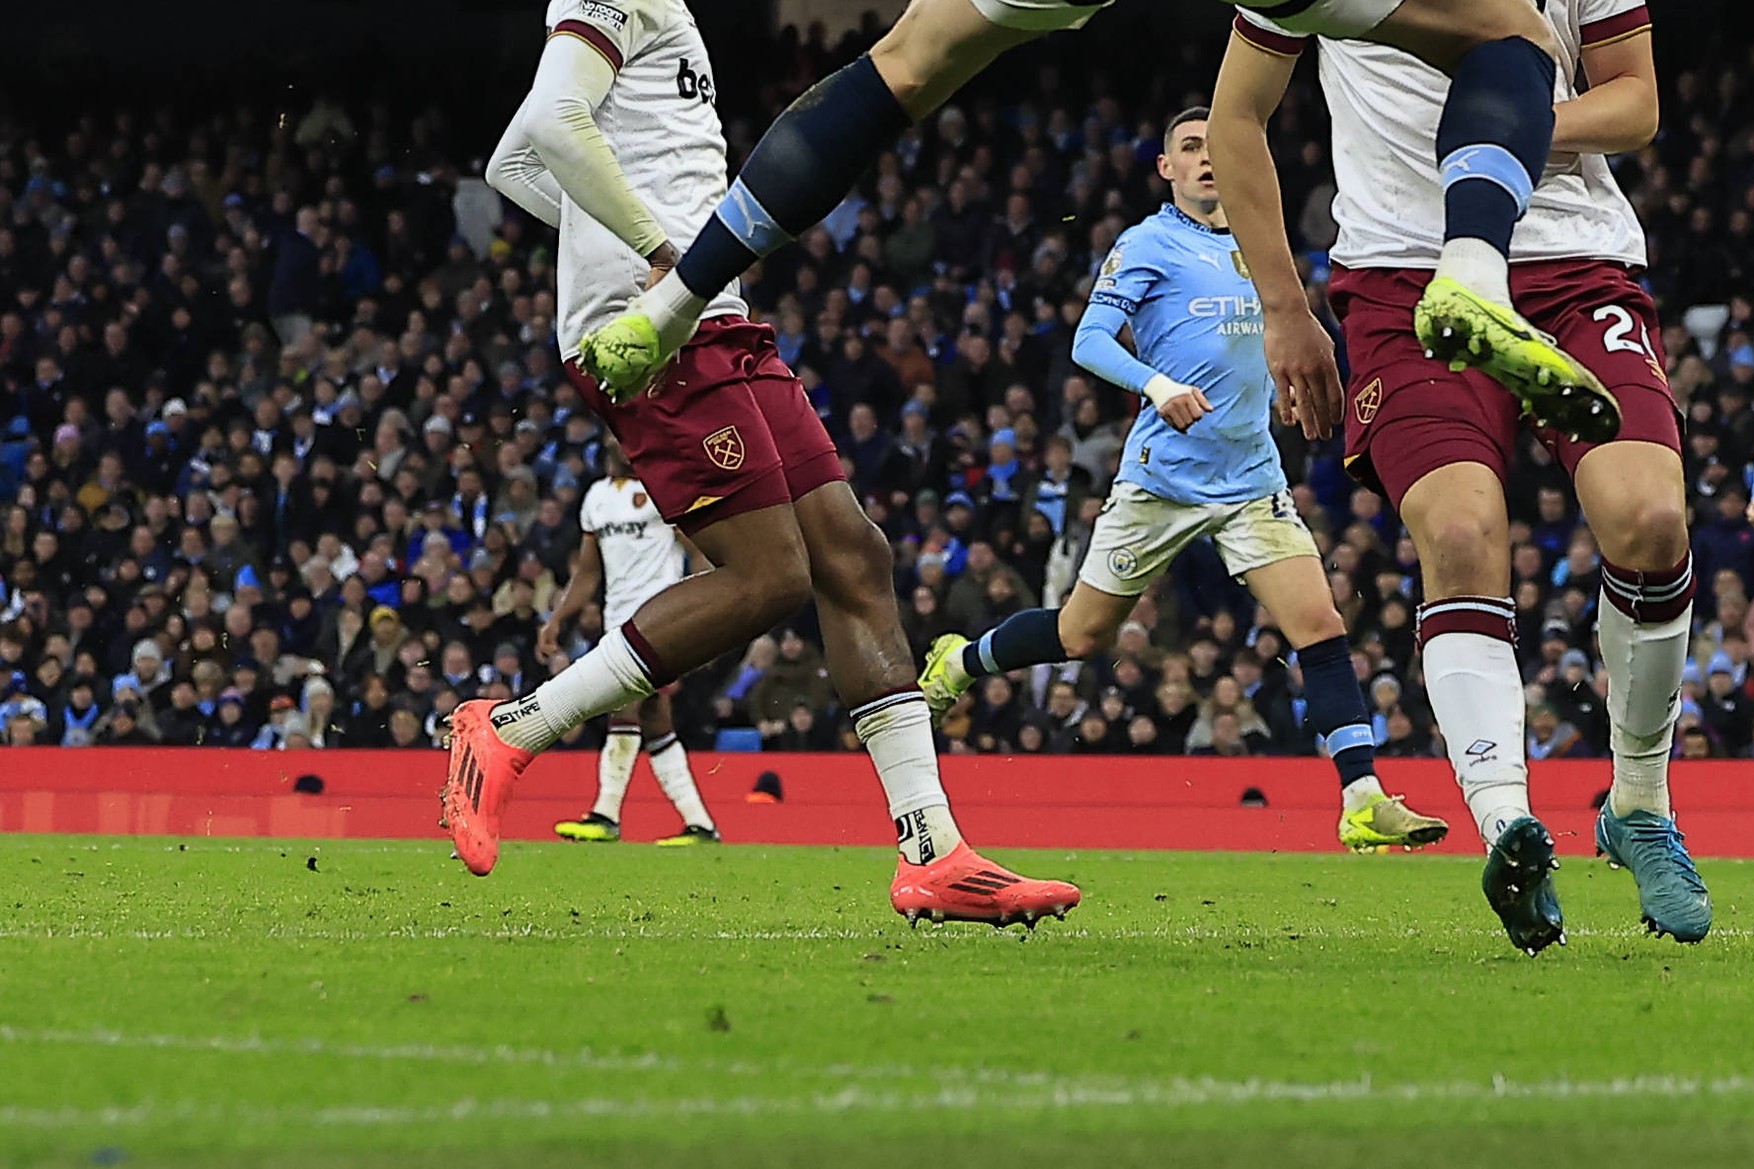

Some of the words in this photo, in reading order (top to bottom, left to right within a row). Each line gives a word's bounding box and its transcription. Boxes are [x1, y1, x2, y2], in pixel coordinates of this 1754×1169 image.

[676, 57, 716, 104] be
[1217, 321, 1265, 336] AIRWAY
[1593, 304, 1658, 366] 2
